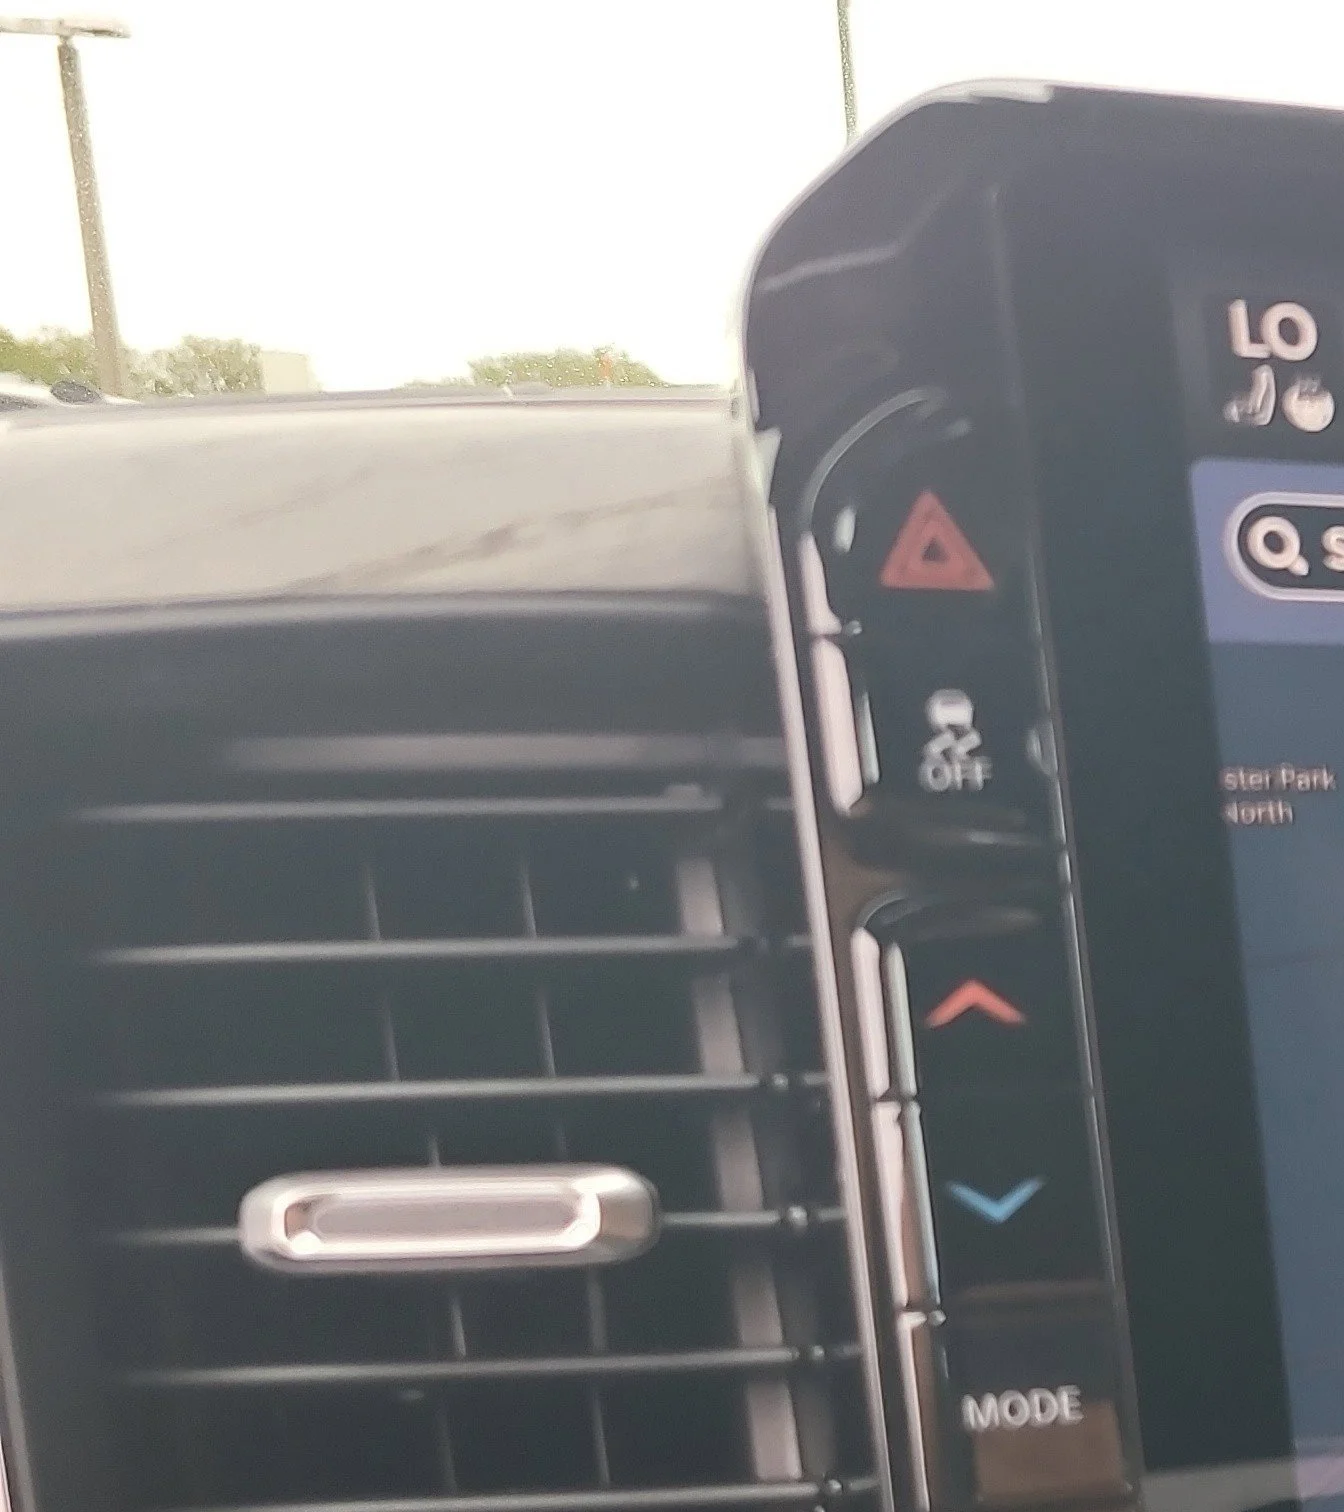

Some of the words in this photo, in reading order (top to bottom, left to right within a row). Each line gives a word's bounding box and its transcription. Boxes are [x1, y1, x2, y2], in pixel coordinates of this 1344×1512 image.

[1227, 299, 1319, 362] LO
[919, 756, 992, 792] OFF
[1280, 762, 1337, 791] Park
[961, 1384, 1085, 1432] MODE
